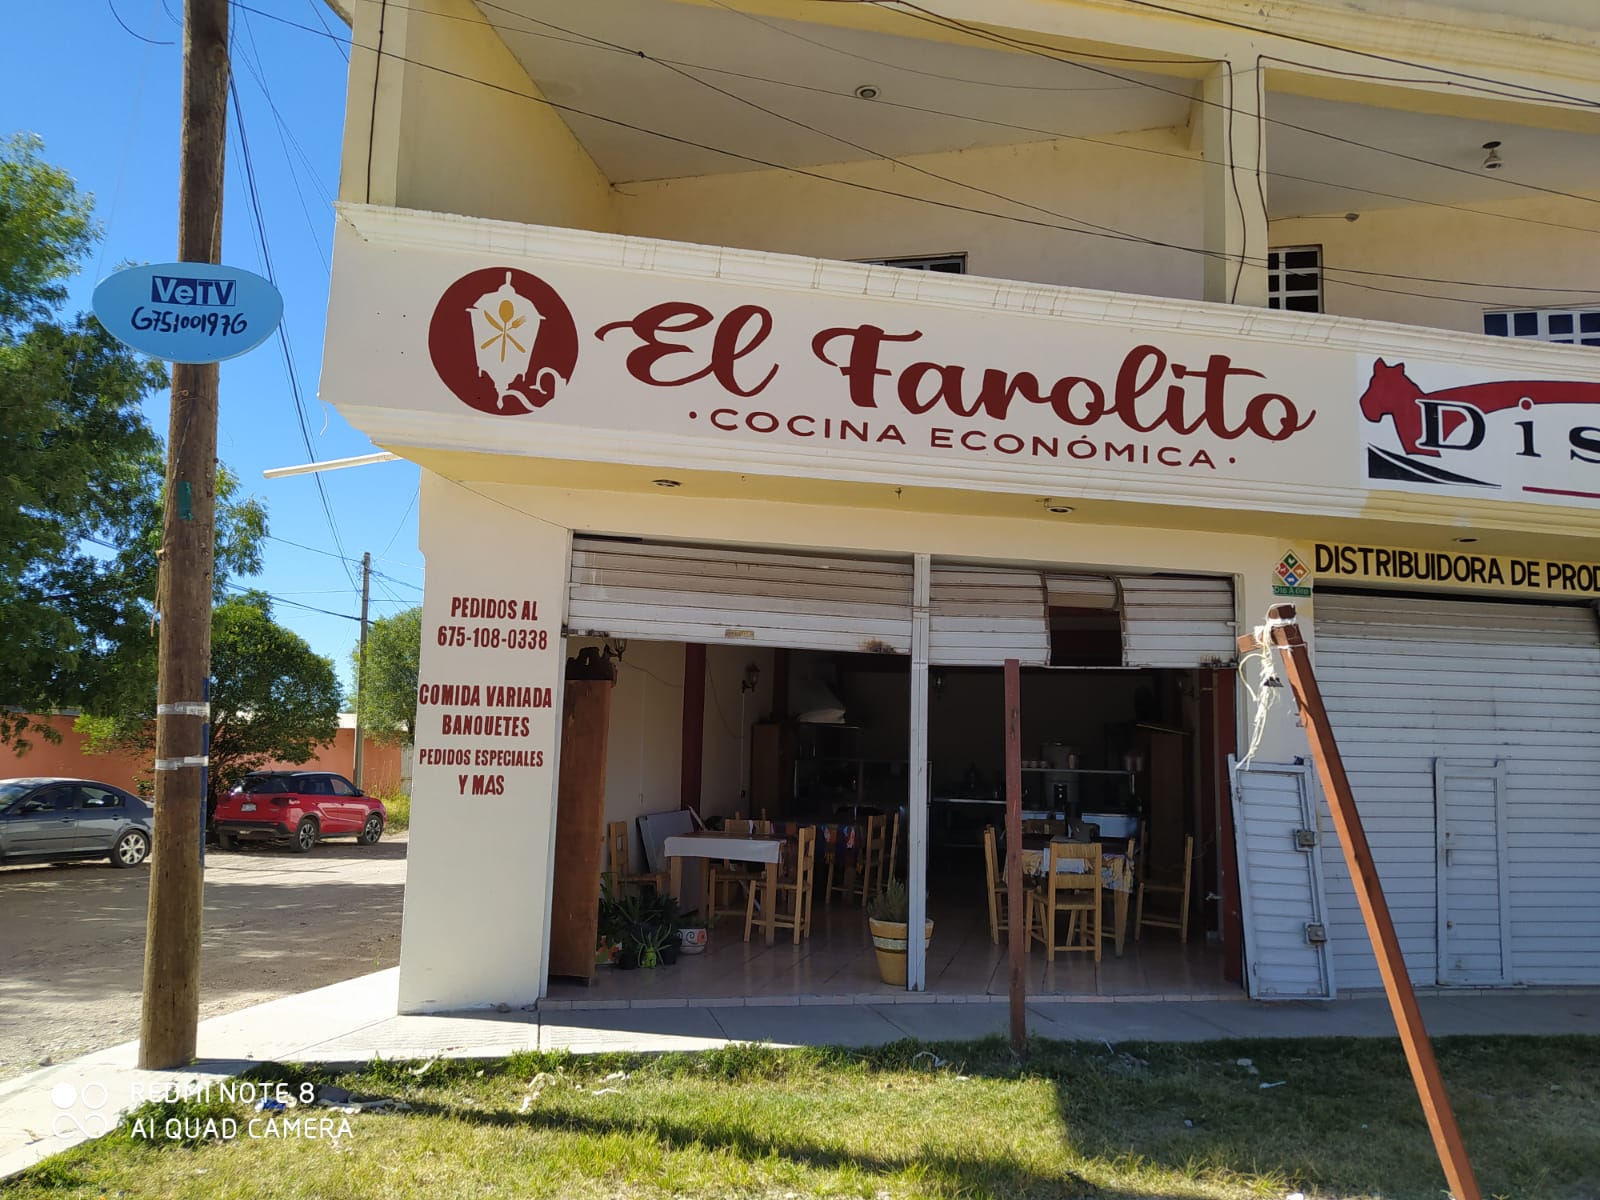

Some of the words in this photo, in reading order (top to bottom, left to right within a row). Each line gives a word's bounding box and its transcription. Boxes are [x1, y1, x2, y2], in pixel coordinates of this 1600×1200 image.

[153, 276, 235, 305] VeTV
[594, 301, 780, 398] El
[811, 324, 1316, 441] Farolito
[710, 407, 906, 446] COCINA
[930, 427, 1216, 470] ECONÓMICA
[1314, 543, 1505, 585] DISTRIBUIDORA
[1510, 559, 1540, 588] DE
[451, 596, 517, 620] PEDIDOS
[521, 600, 538, 621] AL
[437, 626, 548, 650] 675-108-0338
[419, 684, 480, 706] COMIDA
[486, 686, 552, 708] VARIADA
[419, 749, 471, 766] PEDIDOS
[474, 750, 544, 767] ESPECIALES
[458, 774, 469, 795] Y
[471, 775, 505, 796] MAS
